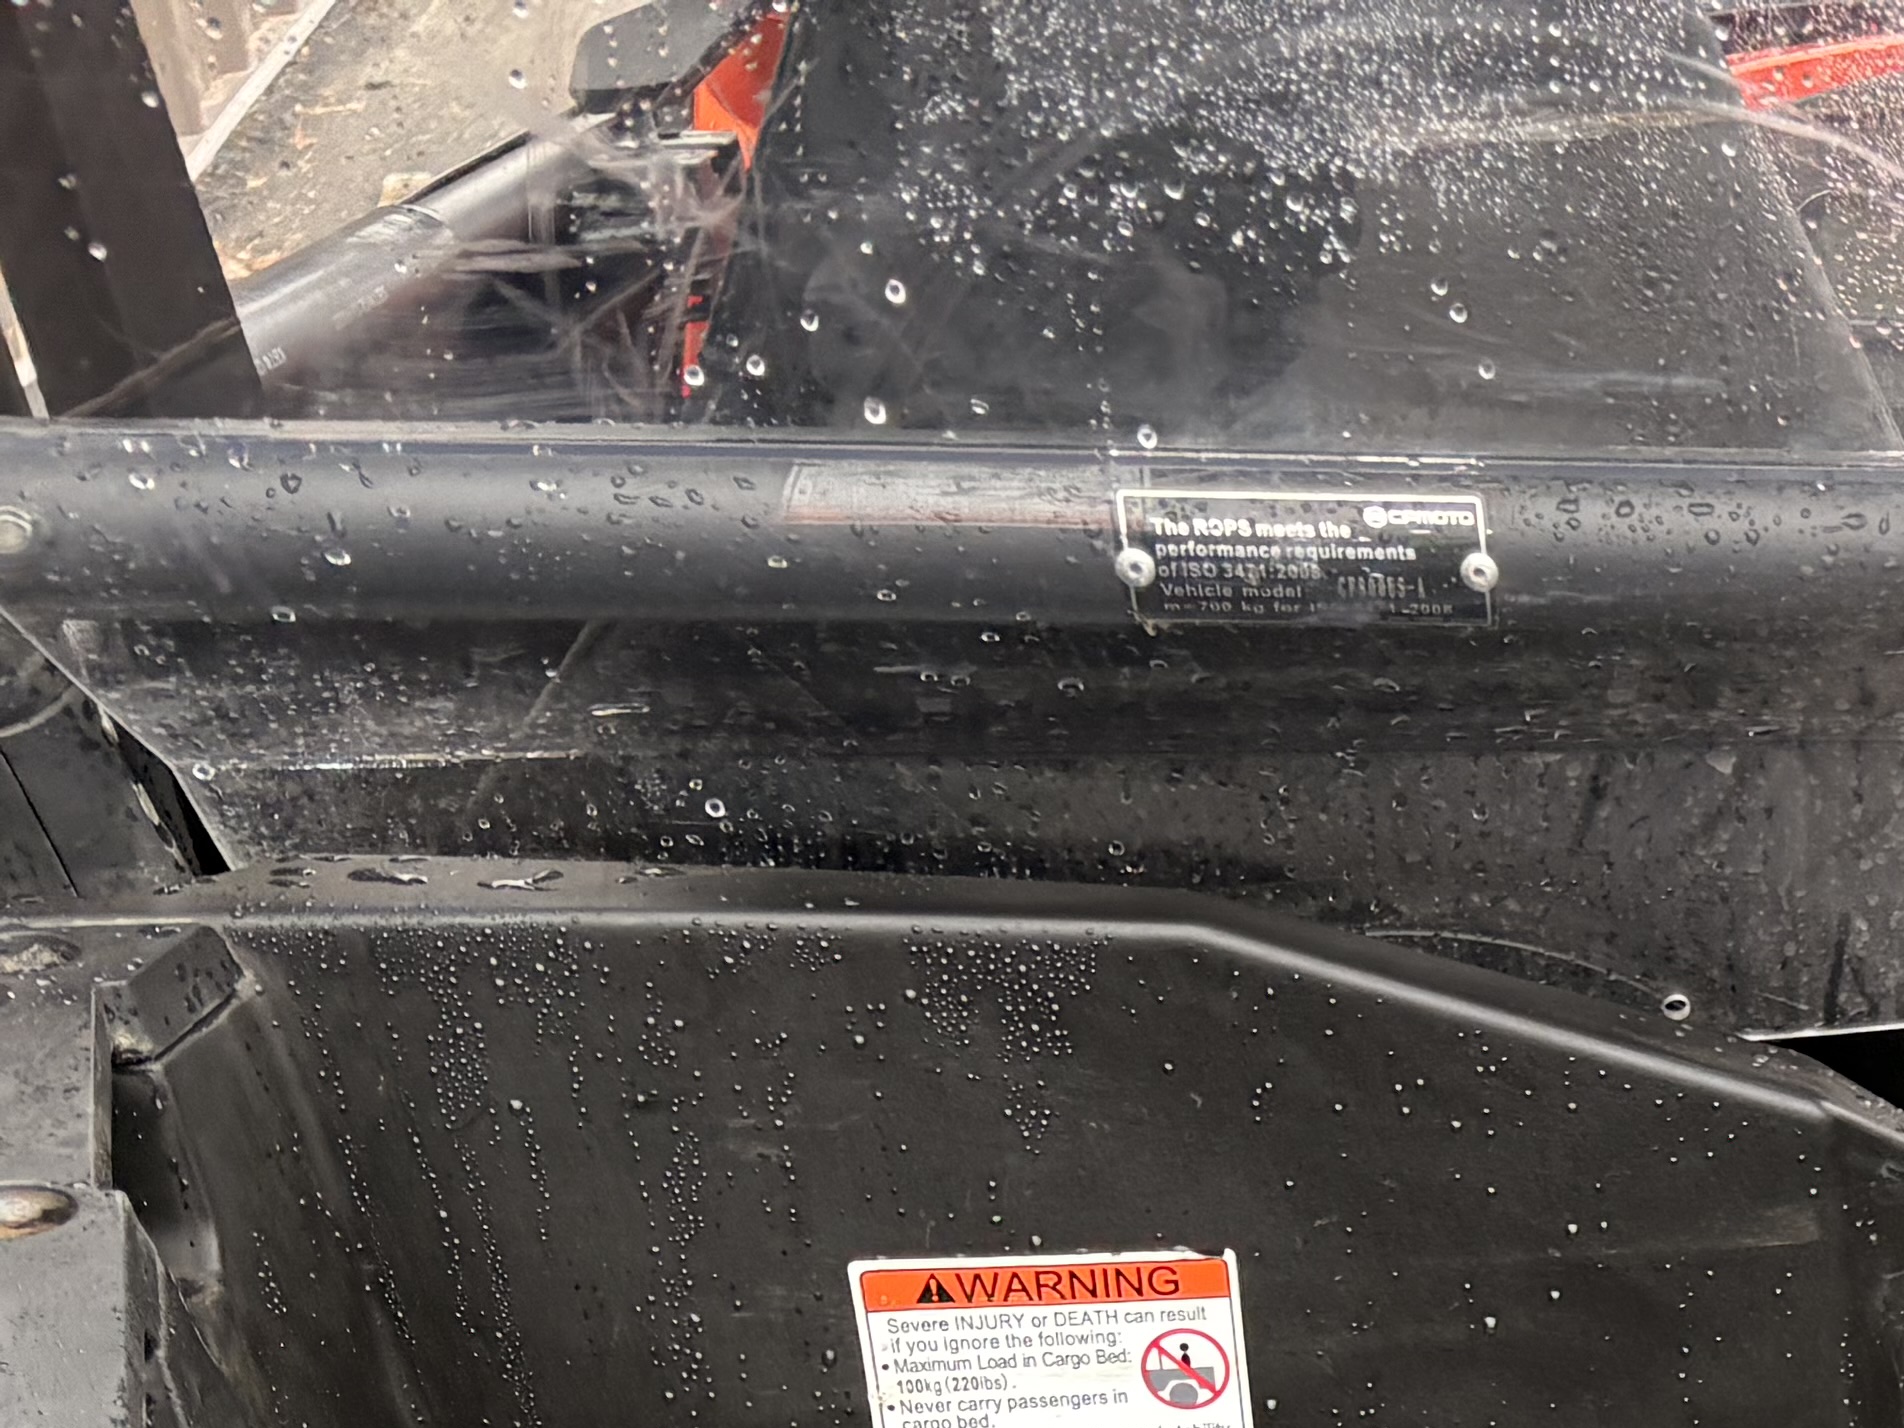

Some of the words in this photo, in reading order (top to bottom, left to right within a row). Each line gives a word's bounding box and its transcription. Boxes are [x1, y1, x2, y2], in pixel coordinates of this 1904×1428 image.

[1150, 517, 1189, 536] The
[1193, 518, 1252, 537] ROPS
[1255, 523, 1316, 538] meets
[1320, 519, 1351, 538] the
[1387, 509, 1475, 527] CFMOTO
[1155, 542, 1280, 559] performance
[1283, 541, 1416, 562] requirements
[1158, 562, 1176, 579] of
[1178, 562, 1217, 579] ISO
[1160, 582, 1233, 599] Vehicle
[1242, 581, 1301, 598] model
[955, 1266, 1180, 1303] WARNING
[887, 1318, 949, 1334] Severe
[955, 1313, 1024, 1330] INJURY
[1031, 1315, 1047, 1327] or
[1054, 1310, 1118, 1327] DEATH
[1124, 1311, 1154, 1324] can
[1160, 1307, 1207, 1323] result
[890, 1338, 900, 1353] if
[902, 1339, 938, 1355] you
[943, 1336, 1000, 1353] ignore
[1006, 1333, 1033, 1348] the
[1038, 1330, 1122, 1349] following:
[894, 1356, 973, 1373] Maximum
[978, 1353, 1018, 1370] Load
[1023, 1355, 1037, 1367] in
[1042, 1352, 1090, 1369] Cargo
[901, 1399, 951, 1415] Never
[958, 1399, 1001, 1414] carry
[1008, 1393, 1107, 1413] passengers
[1113, 1390, 1128, 1404] in
